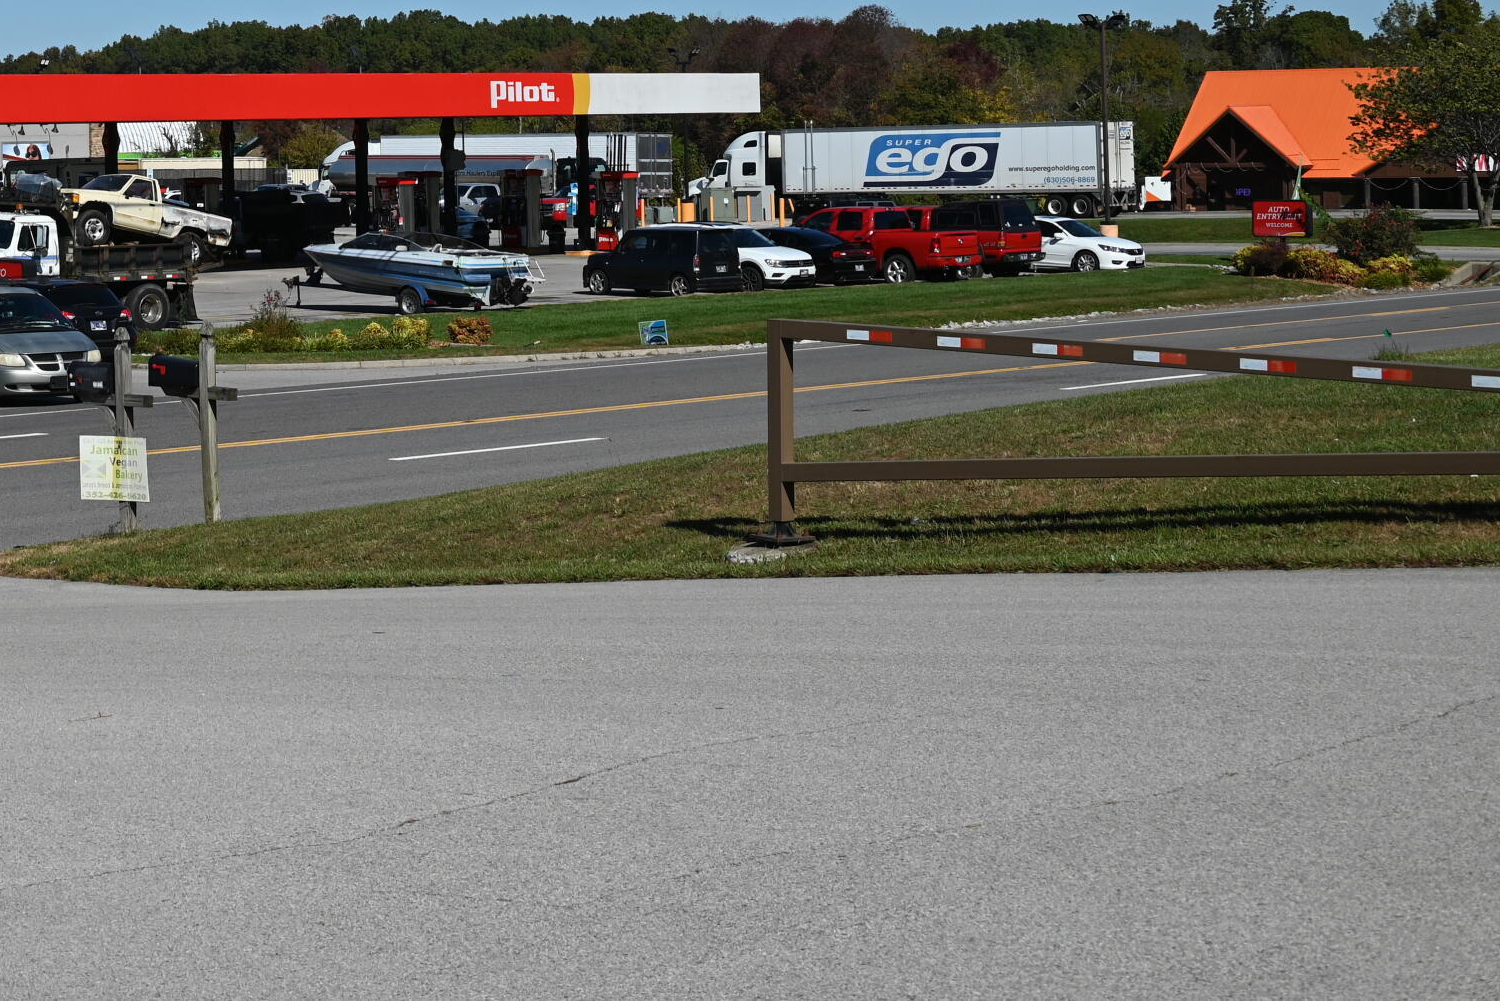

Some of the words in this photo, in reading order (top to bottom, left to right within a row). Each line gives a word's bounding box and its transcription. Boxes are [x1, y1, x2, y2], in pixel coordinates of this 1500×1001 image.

[490, 80, 556, 109] Pilot
[886, 139, 932, 147] SUPER
[1008, 164, 1096, 173] www.superegoholding.com
[90, 444, 138, 456] Jamaican
[109, 456, 138, 468] Vegan
[115, 469, 143, 483] Bakery
